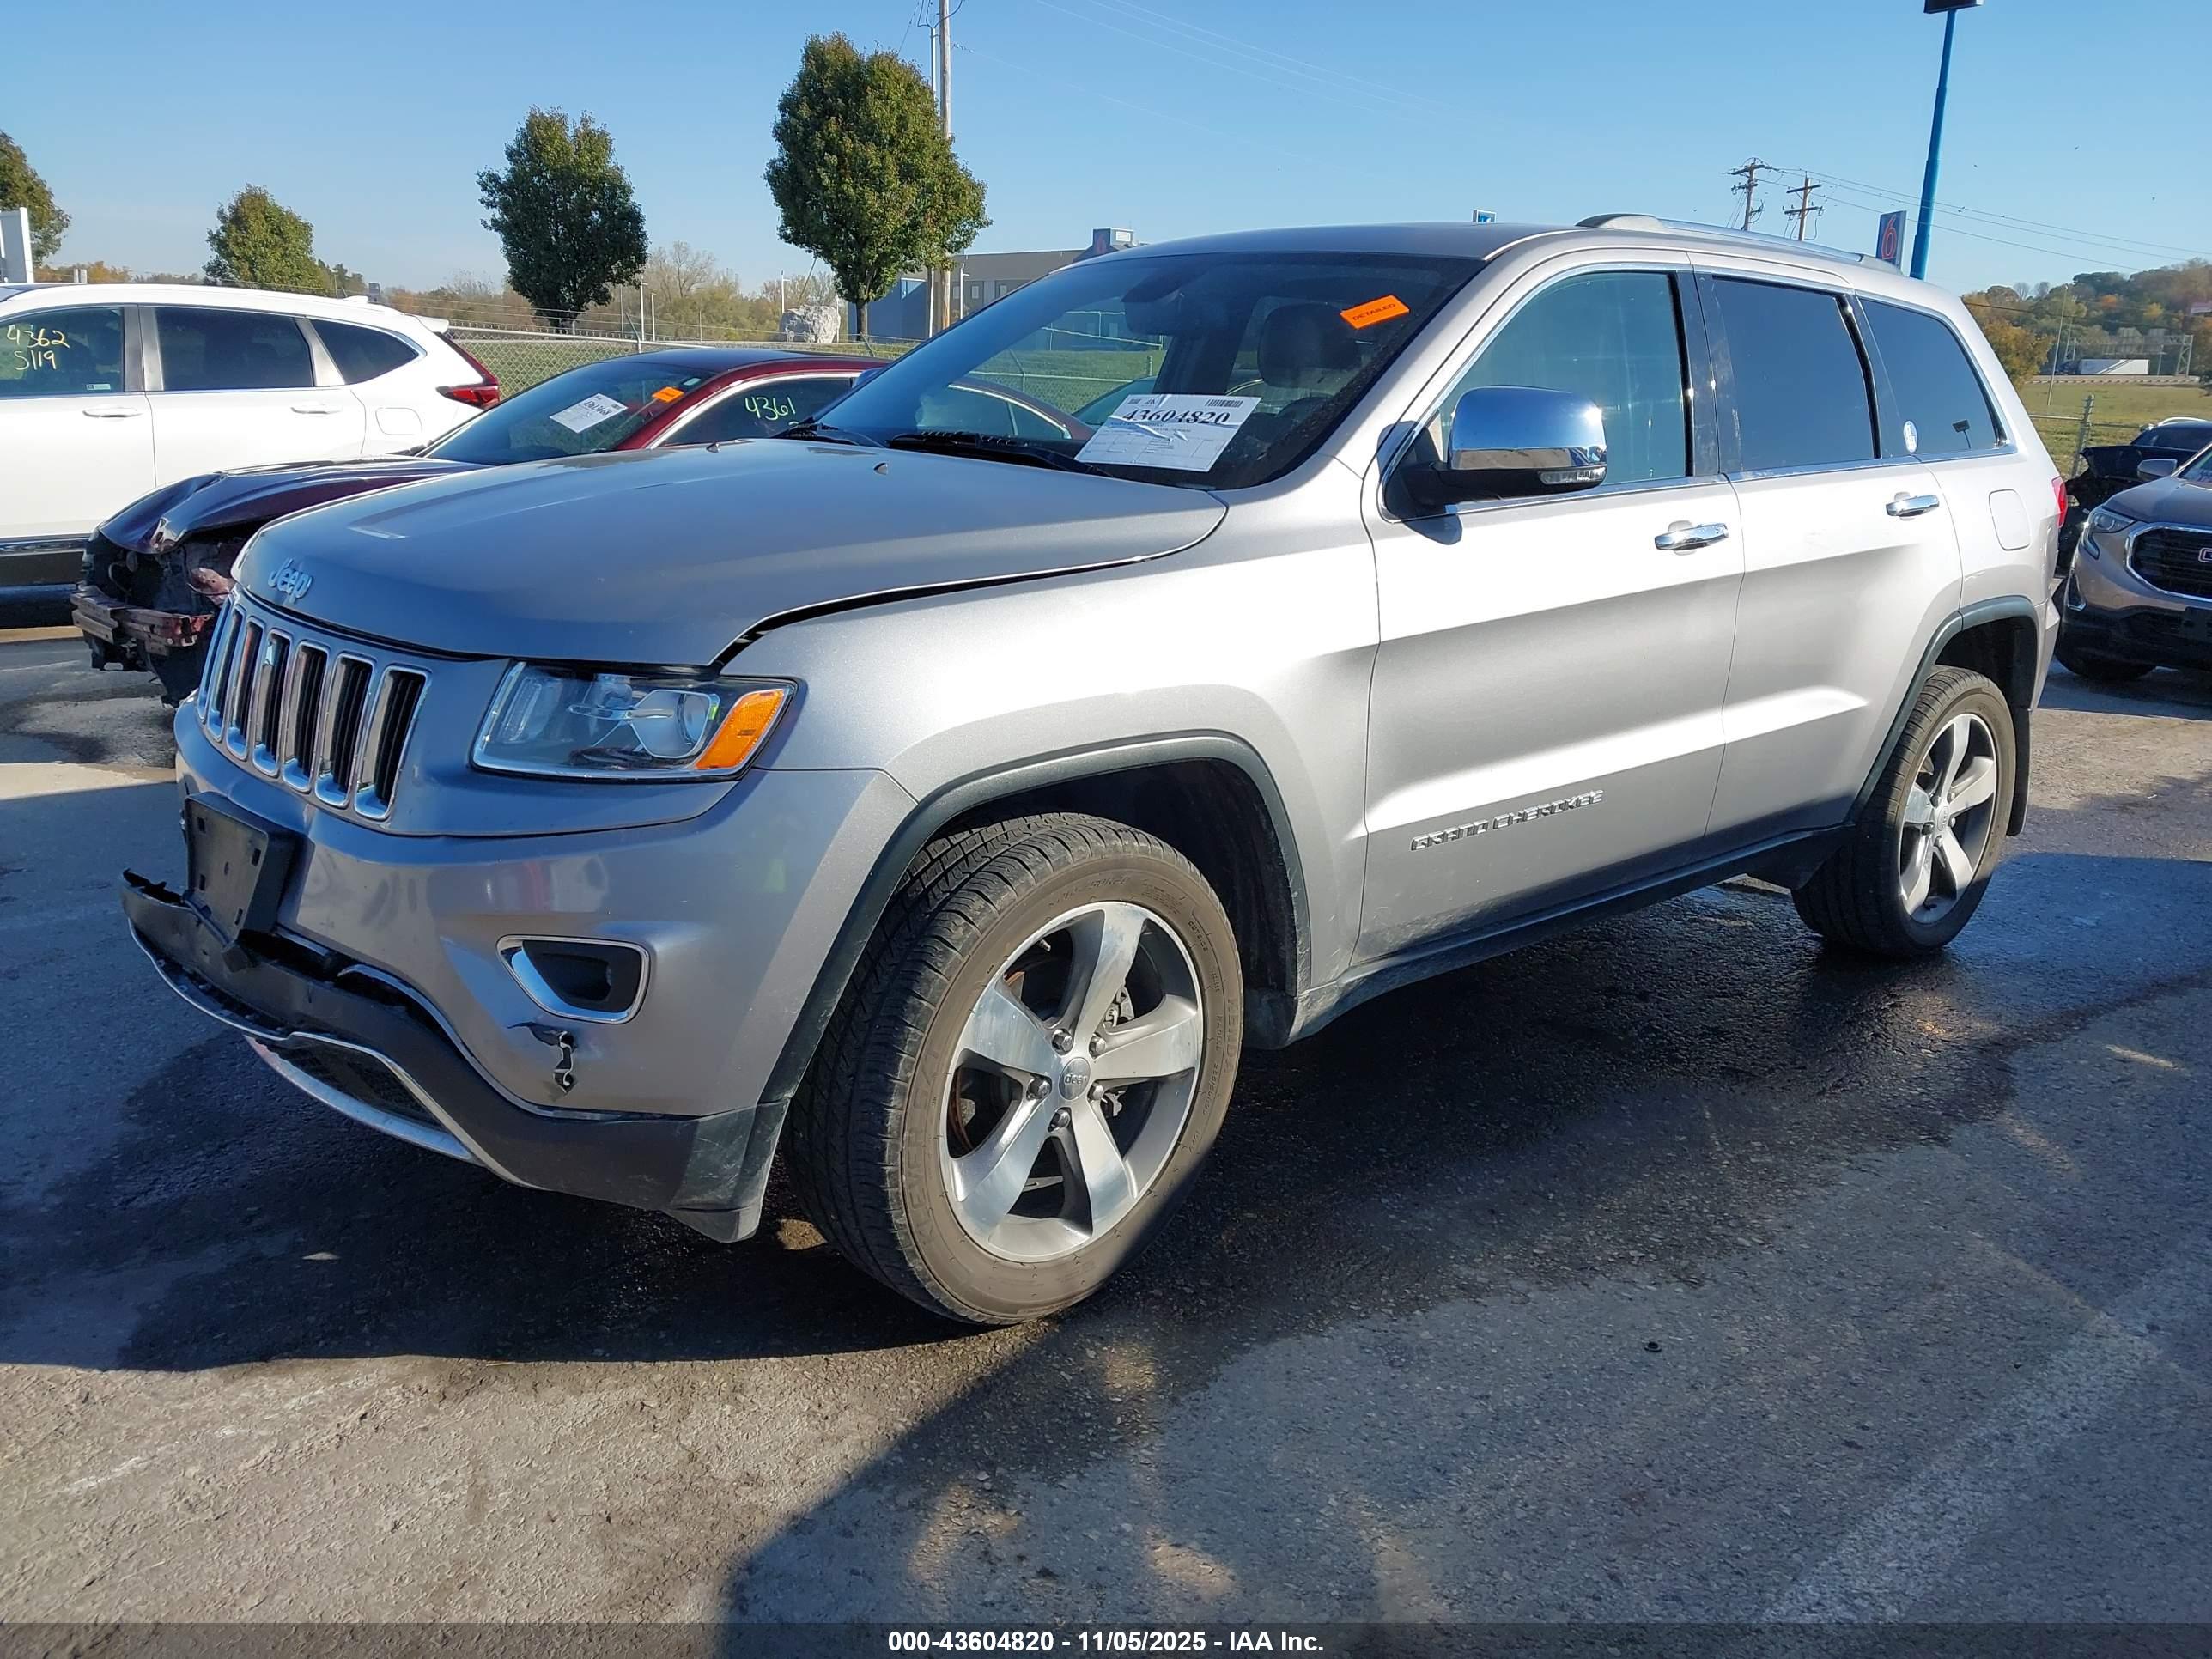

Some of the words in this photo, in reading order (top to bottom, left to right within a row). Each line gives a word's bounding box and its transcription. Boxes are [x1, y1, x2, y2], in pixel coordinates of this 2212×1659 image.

[1881, 214, 1897, 259] 6
[7, 324, 70, 349] 4362
[744, 397, 796, 420] 4361
[1122, 408, 1231, 425] 43604820
[268, 558, 313, 605] Jeep
[1409, 818, 1489, 851] GRAND
[1492, 788, 1604, 830] CHEROKEE
